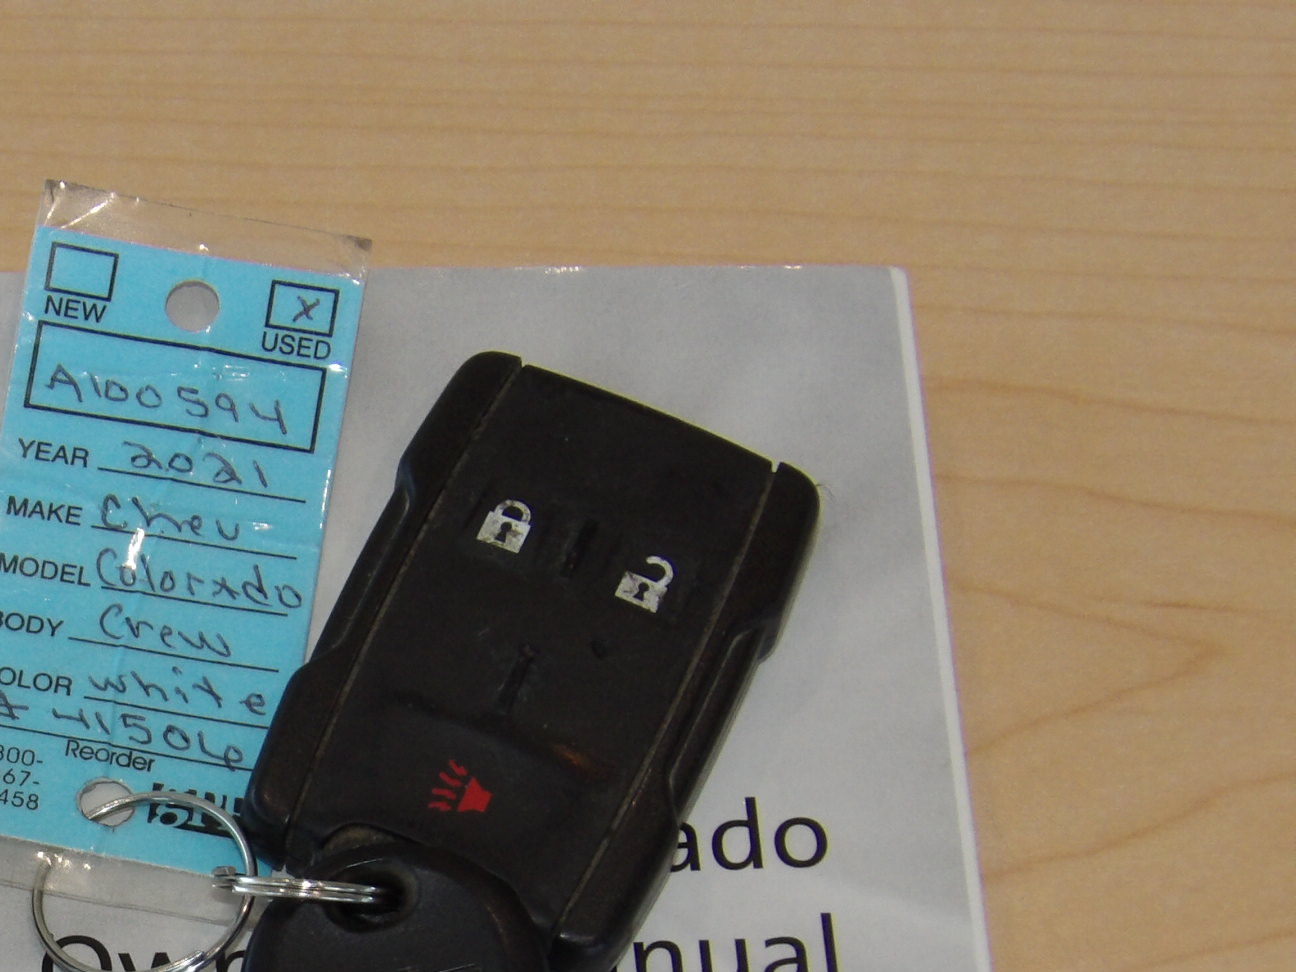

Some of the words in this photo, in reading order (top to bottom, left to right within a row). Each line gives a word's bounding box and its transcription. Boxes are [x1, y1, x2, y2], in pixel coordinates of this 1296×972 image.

[44, 295, 108, 324] NEW
[261, 331, 333, 361] USED
[45, 363, 288, 436] A100594
[17, 437, 90, 469] YEAR
[122, 441, 269, 489] 2021
[5, 495, 84, 528] MAKE
[96, 547, 303, 609] Colorado
[64, 738, 155, 773] Reorder
